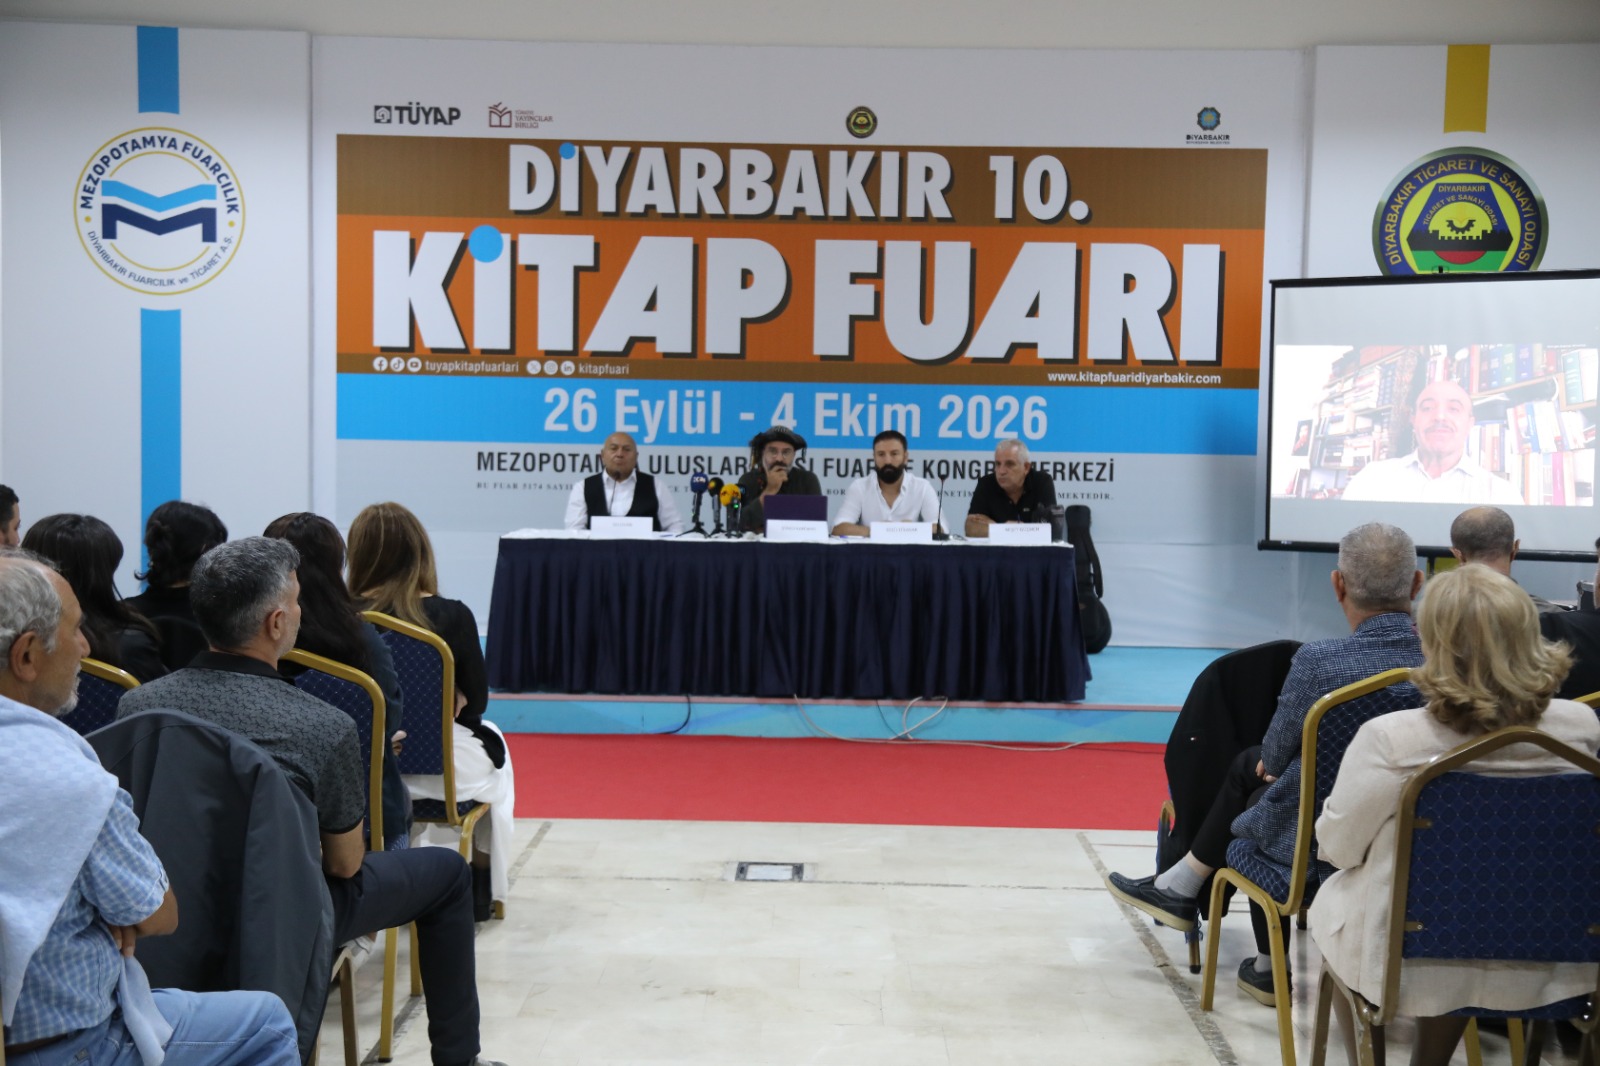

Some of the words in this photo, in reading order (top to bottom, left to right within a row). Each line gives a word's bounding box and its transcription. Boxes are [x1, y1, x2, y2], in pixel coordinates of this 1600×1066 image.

[394, 101, 461, 125] TÜYAP
[80, 135, 178, 209] MEZOPOTAMYA
[181, 141, 240, 214] FUARCILIK
[508, 143, 953, 219] DİYARBAKIR
[989, 154, 1091, 221] 10.
[1413, 159, 1478, 184] TİCARET
[1438, 184, 1486, 193] DİYARBAKIR
[1481, 162, 1500, 178] VE
[1499, 172, 1538, 218] SANAYİ
[1384, 181, 1416, 266] DİYARBAKIR
[87, 230, 127, 277] DİYARBAKIR
[128, 271, 176, 287] FUARCILIK
[179, 276, 189, 285] ve
[190, 252, 222, 280] TİCARET
[1515, 221, 1537, 266] ODASI
[373, 225, 789, 355] KİTAP
[813, 239, 1222, 362] FUARI
[425, 361, 520, 374] tuyapkitapfuarlari
[579, 363, 630, 376] kitapfuari
[1047, 371, 1222, 385] www.kitapfuaridiyarbakir.com
[543, 386, 598, 433] 26
[615, 388, 722, 442] Eylül
[770, 393, 798, 430] 4
[813, 392, 921, 438] Ekim
[938, 394, 1048, 441] 2026
[477, 451, 605, 473] MEZOPOTAM
[649, 453, 814, 476] ULUSLARSI
[922, 458, 996, 481] KONGR
